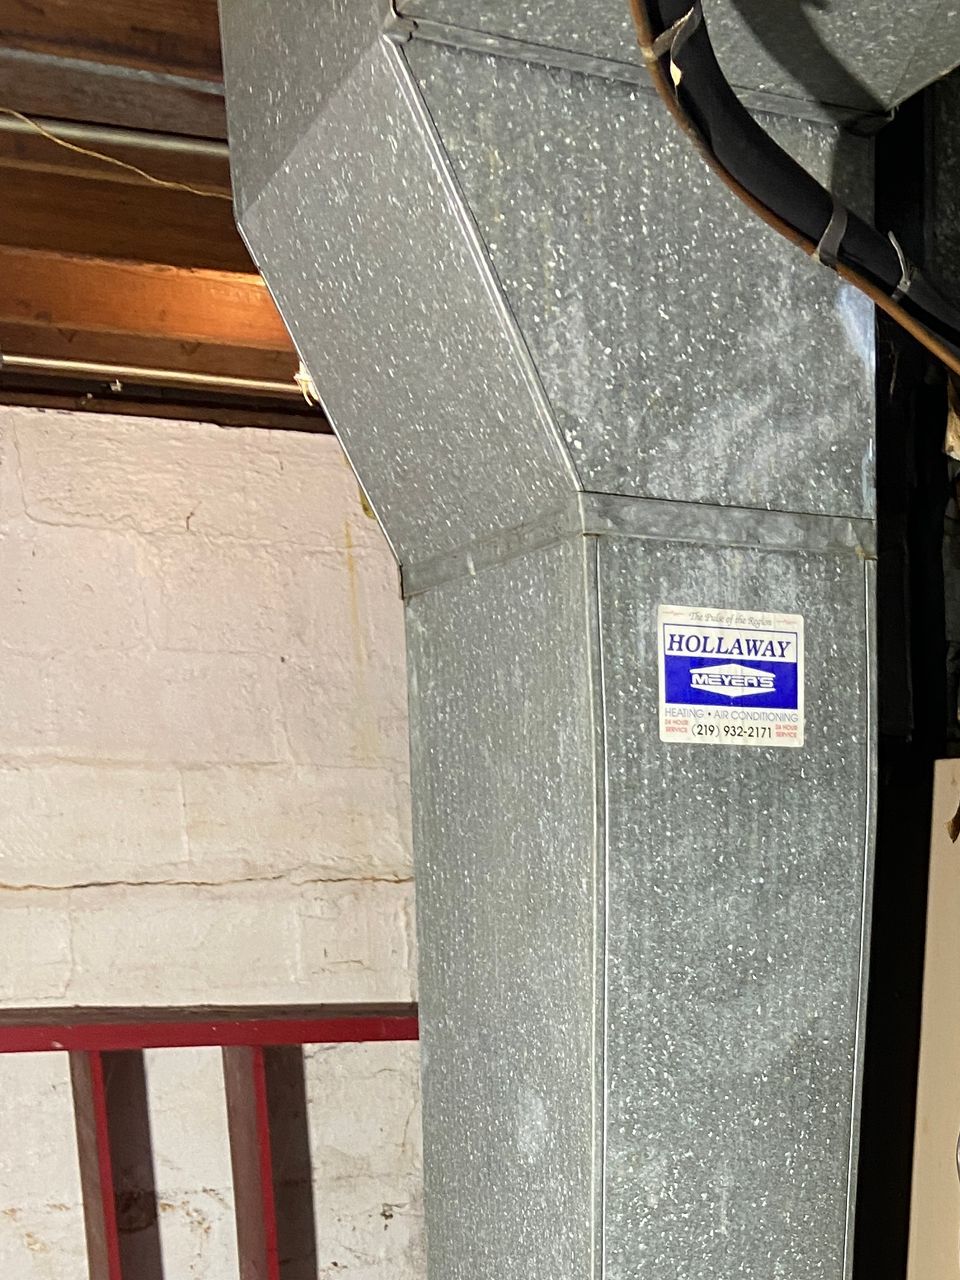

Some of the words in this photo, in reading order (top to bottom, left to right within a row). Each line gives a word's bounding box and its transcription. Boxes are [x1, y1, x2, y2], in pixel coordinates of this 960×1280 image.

[667, 634, 791, 658] HOLLAWAY
[692, 673, 774, 688] MEYER'S
[665, 708, 704, 719] HEATING
[714, 710, 730, 719] AIR
[731, 711, 799, 722] CONDITIONING
[691, 724, 720, 737] (219)
[724, 726, 772, 738] 932-2171
